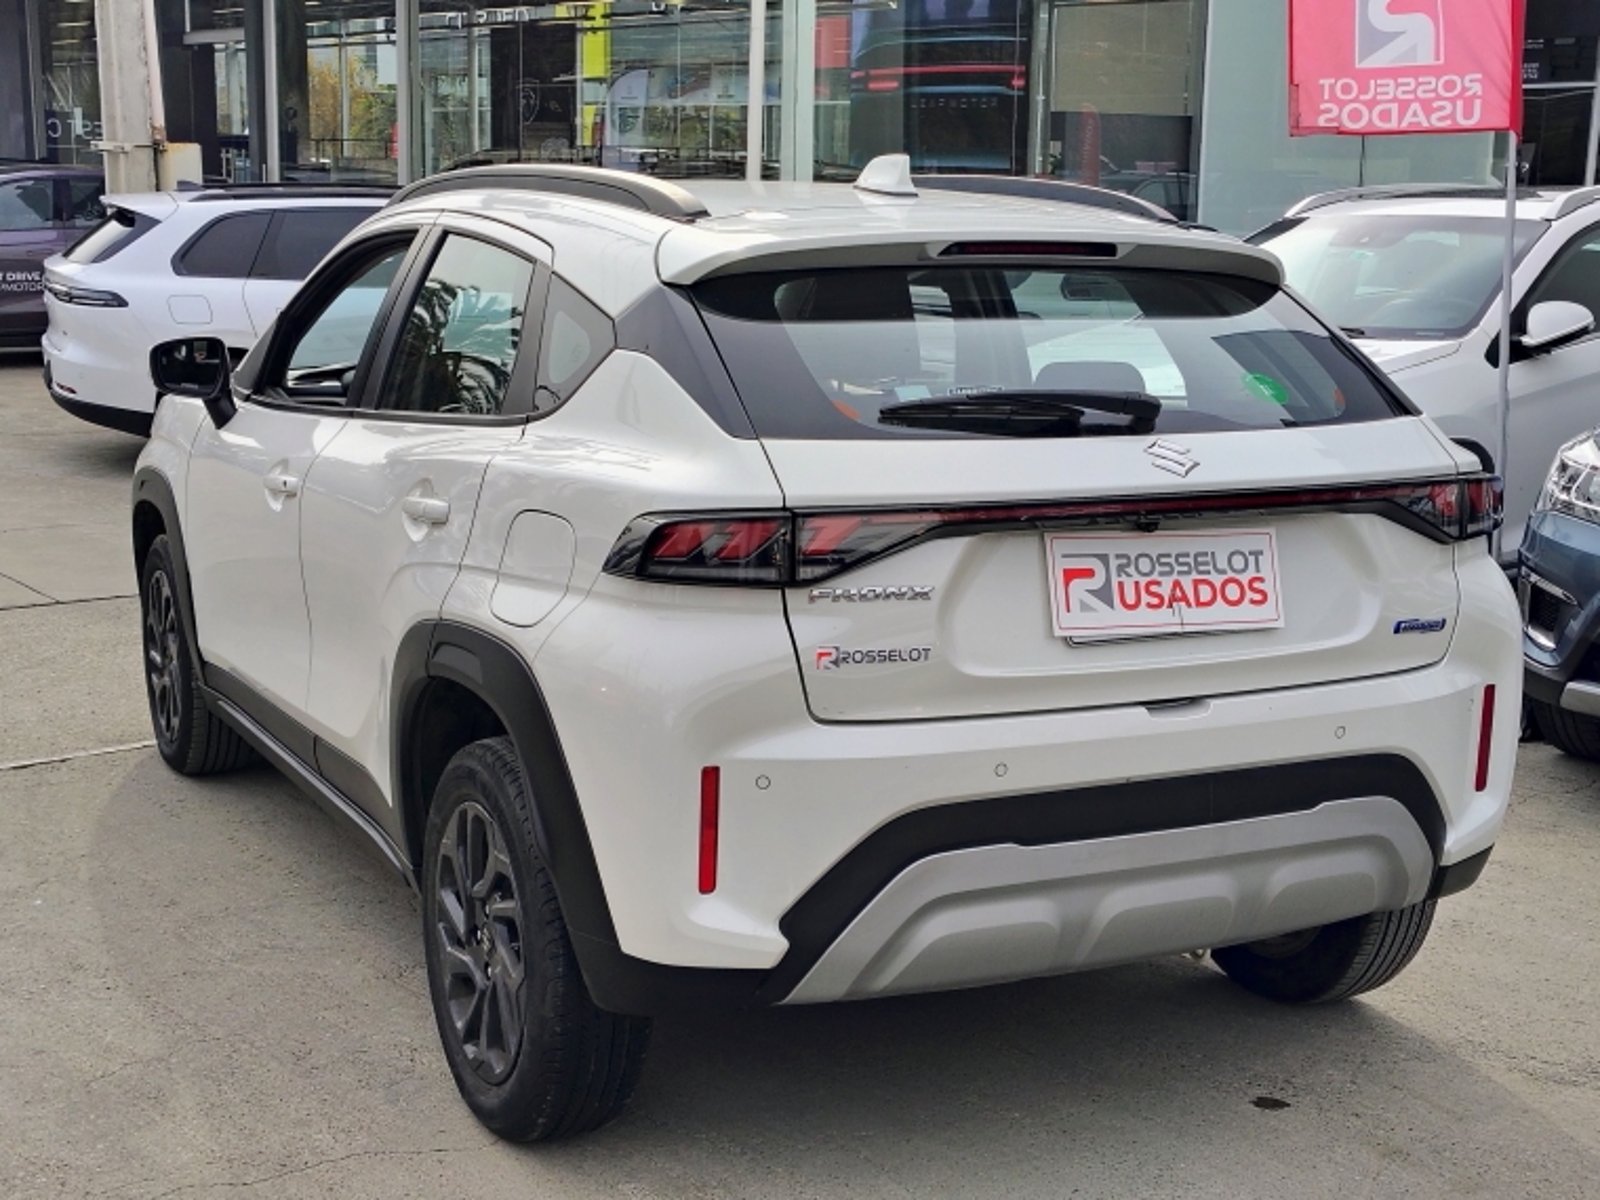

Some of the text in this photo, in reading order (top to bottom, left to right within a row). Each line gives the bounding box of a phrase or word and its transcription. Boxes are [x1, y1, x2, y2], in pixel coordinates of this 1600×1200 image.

[1114, 550, 1264, 578] ROSSELOT
[808, 585, 935, 604] FRONX
[1117, 576, 1269, 611] USADOS
[840, 647, 932, 665] ROSSELOT
